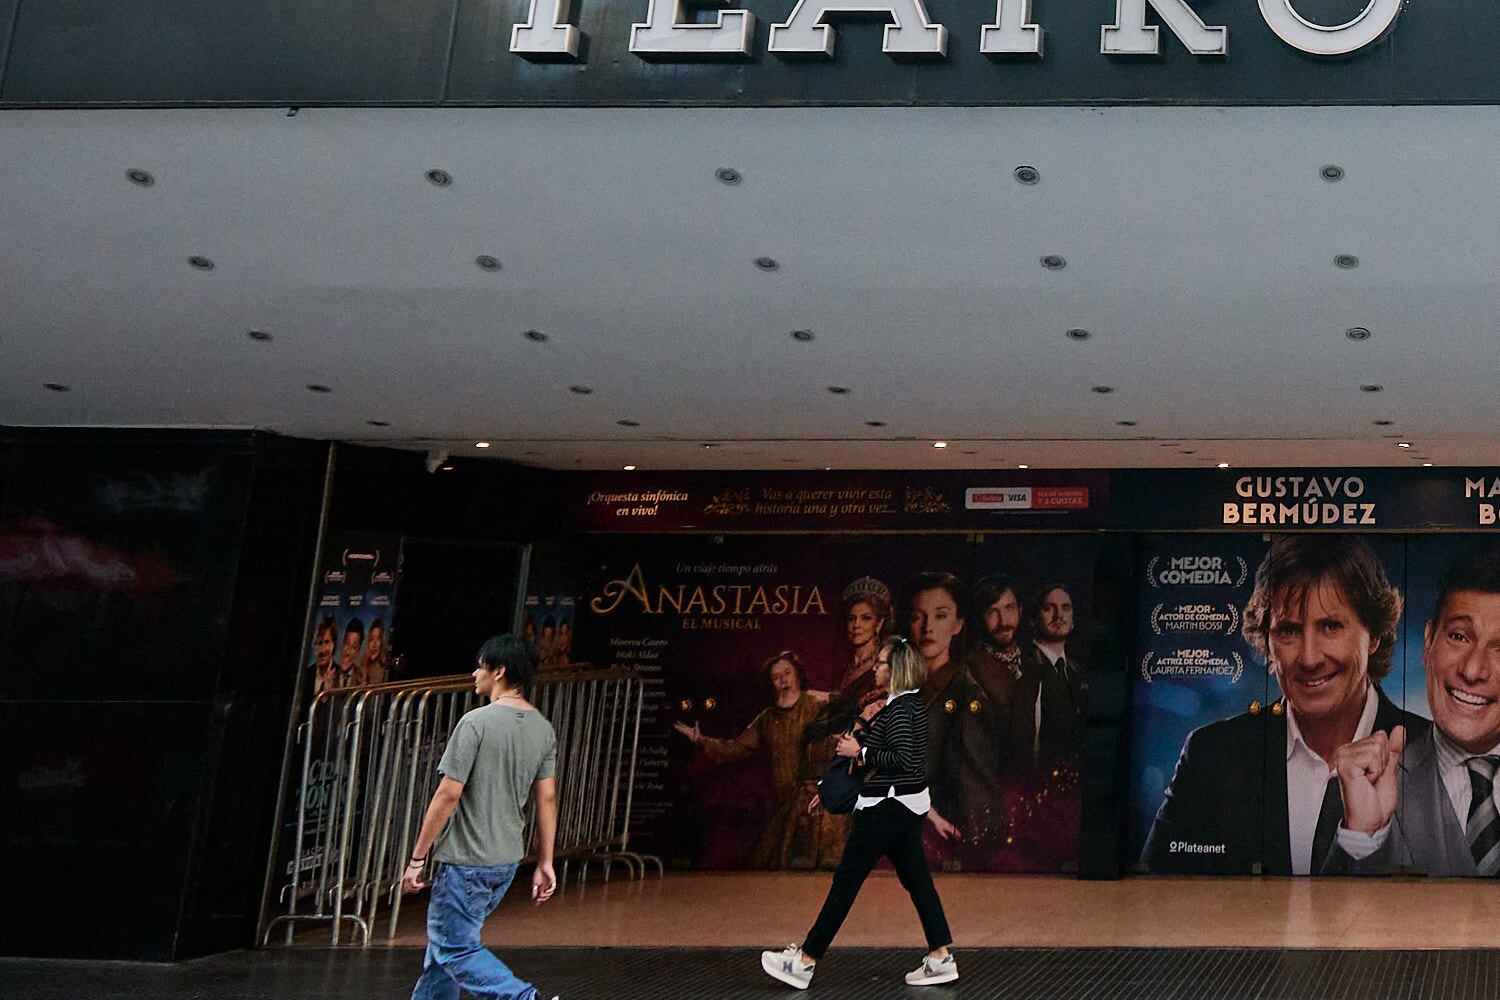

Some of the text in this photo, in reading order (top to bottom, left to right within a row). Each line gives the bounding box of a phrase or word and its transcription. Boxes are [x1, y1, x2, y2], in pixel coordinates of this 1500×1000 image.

[1235, 476, 1365, 498] GUSTAVO
[587, 489, 688, 505] ¡Orquesta sinfónica
[796, 490, 835, 503] querer
[837, 489, 866, 500] vivir
[868, 489, 892, 500] esta
[1008, 494, 1027, 502] VISA
[616, 505, 659, 516] en vivo!
[755, 502, 800, 514] historia
[803, 504, 827, 514] una
[828, 504, 838, 518] y
[840, 503, 866, 514] otra
[1223, 497, 1377, 524] BERMÚDEZ
[675, 563, 691, 574] Un
[717, 563, 751, 576] tiempo
[1171, 556, 1222, 570] MEJOR
[1159, 570, 1232, 585] COMEDIA
[589, 561, 828, 616] ANASTASIA
[1179, 605, 1210, 613] MEJOR
[1158, 613, 1230, 621] ACTOR DE COMEDIA
[682, 618, 761, 630] EL MUSICAL
[1165, 621, 1223, 630] MARTIN BOSSI
[1177, 650, 1210, 658] MEJOR
[1150, 666, 1234, 675] LAURITA FERNANDEZ
[1177, 841, 1226, 854] Plateanet
